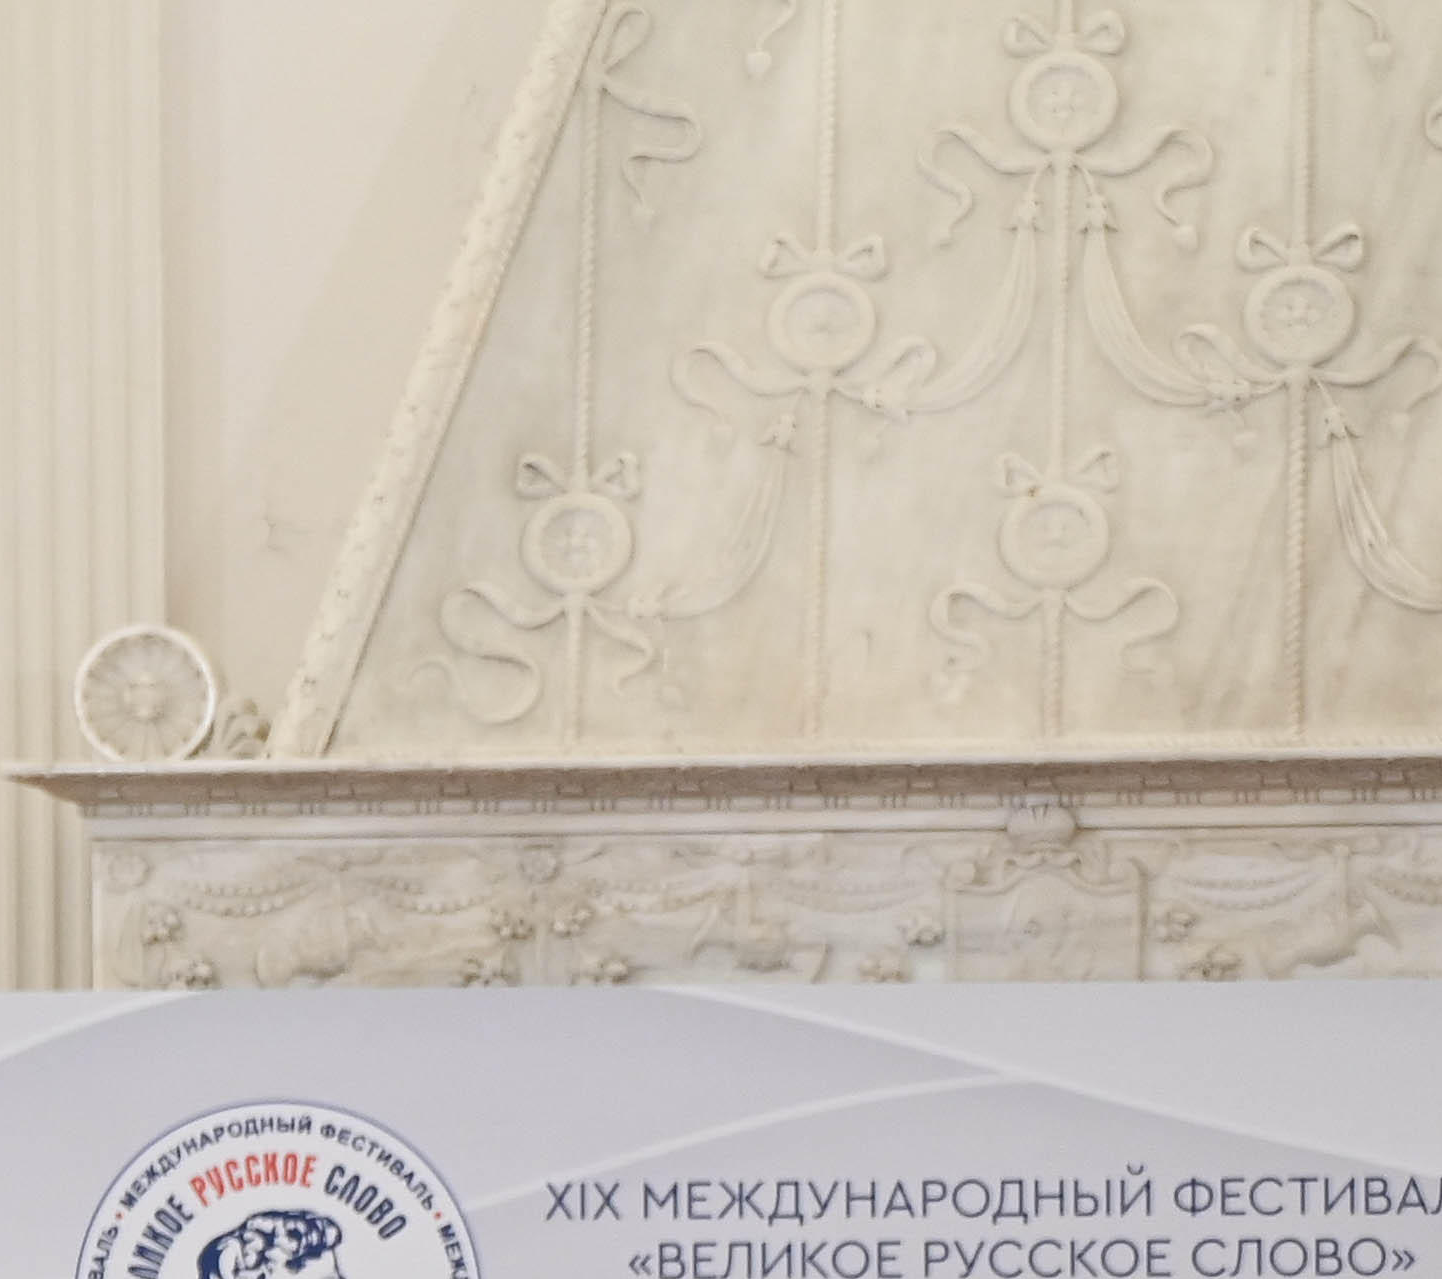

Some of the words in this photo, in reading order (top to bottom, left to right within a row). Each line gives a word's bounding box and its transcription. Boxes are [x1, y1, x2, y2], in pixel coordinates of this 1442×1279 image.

[120, 1115, 313, 1212] МЕЖДУНАРОДНЫЙ
[320, 1118, 435, 1211] ФЕСТИВАЛЬ
[189, 1152, 320, 1206] РУССКОЕ
[324, 1164, 408, 1241] СЛОВО
[642, 1164, 1153, 1226] МЕЖДУНАРОДНЫЙ
[628, 1240, 903, 1279] «ВЕЛИКОЕ
[922, 1239, 1173, 1279] РУССКОЕ
[1190, 1238, 1416, 1277] СЛОВО»
